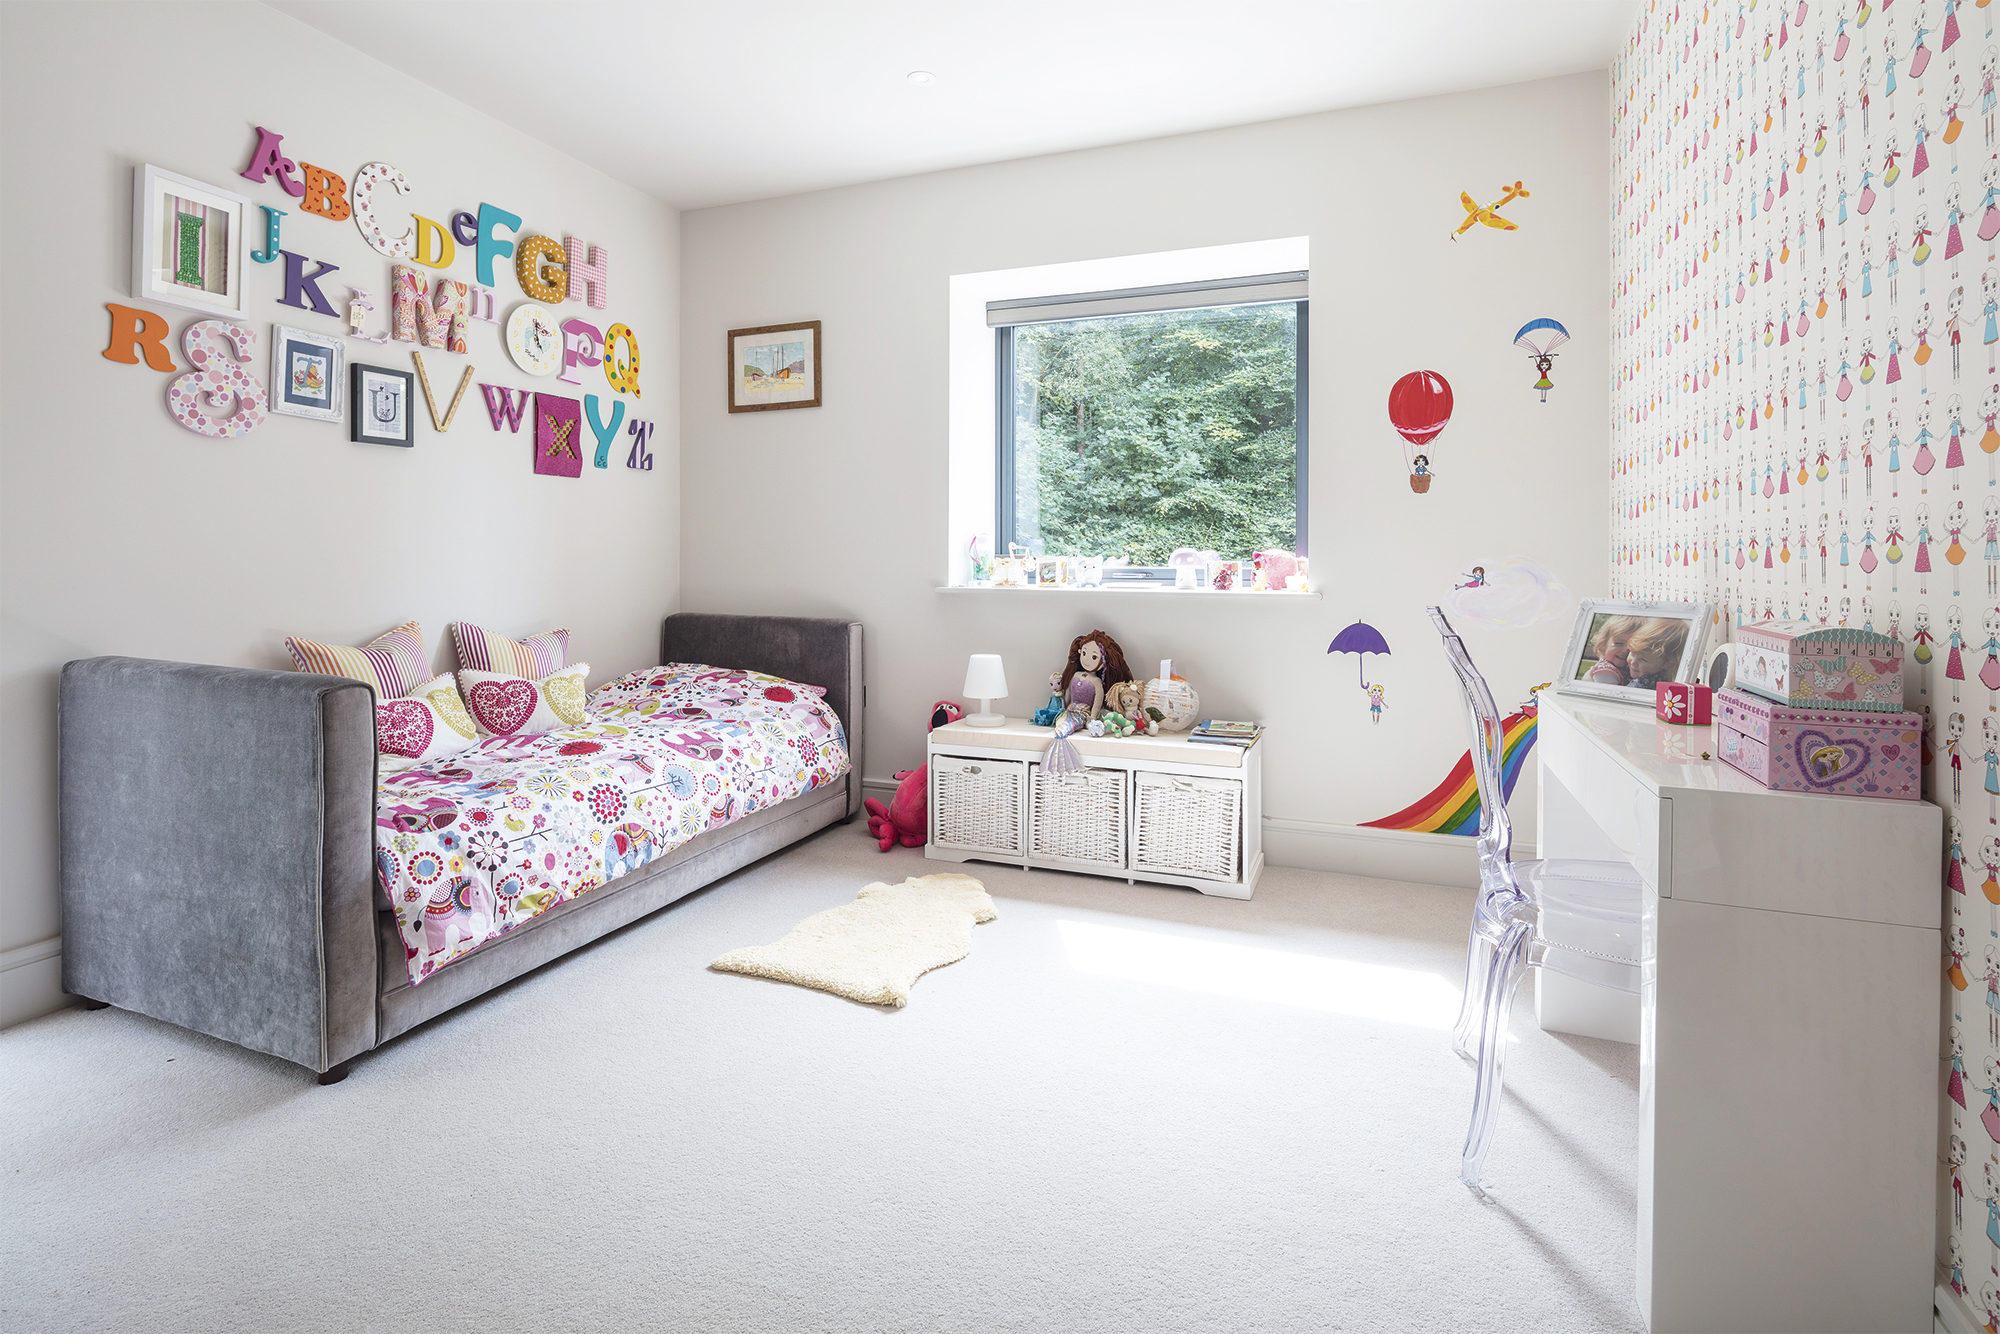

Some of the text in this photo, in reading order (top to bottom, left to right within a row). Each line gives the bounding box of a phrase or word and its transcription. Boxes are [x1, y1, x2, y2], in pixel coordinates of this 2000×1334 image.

[240, 126, 305, 197] A
[300, 162, 351, 221] B
[353, 162, 414, 258] C
[412, 213, 455, 269] D
[477, 202, 522, 287] F
[517, 234, 568, 304] G
[564, 235, 608, 310] H
[176, 211, 205, 286] I
[251, 205, 288, 263] J
[277, 250, 340, 318] K
[392, 264, 468, 354] M
[557, 318, 605, 385] P
[604, 323, 641, 399] Q
[523, 309, 530, 318] 11
[535, 310, 542, 319] 12
[513, 330, 519, 338] 9
[552, 328, 557, 337] 2
[514, 343, 520, 352] 8
[553, 341, 559, 349] 3
[550, 353, 555, 361] 4
[532, 362, 538, 370] 6
[543, 362, 549, 370] 5
[102, 303, 177, 373] R
[165, 320, 268, 438] S
[368, 388, 400, 423] U
[545, 414, 578, 460] X
[585, 394, 625, 469] Y
[1868, 649, 1874, 657] 5
